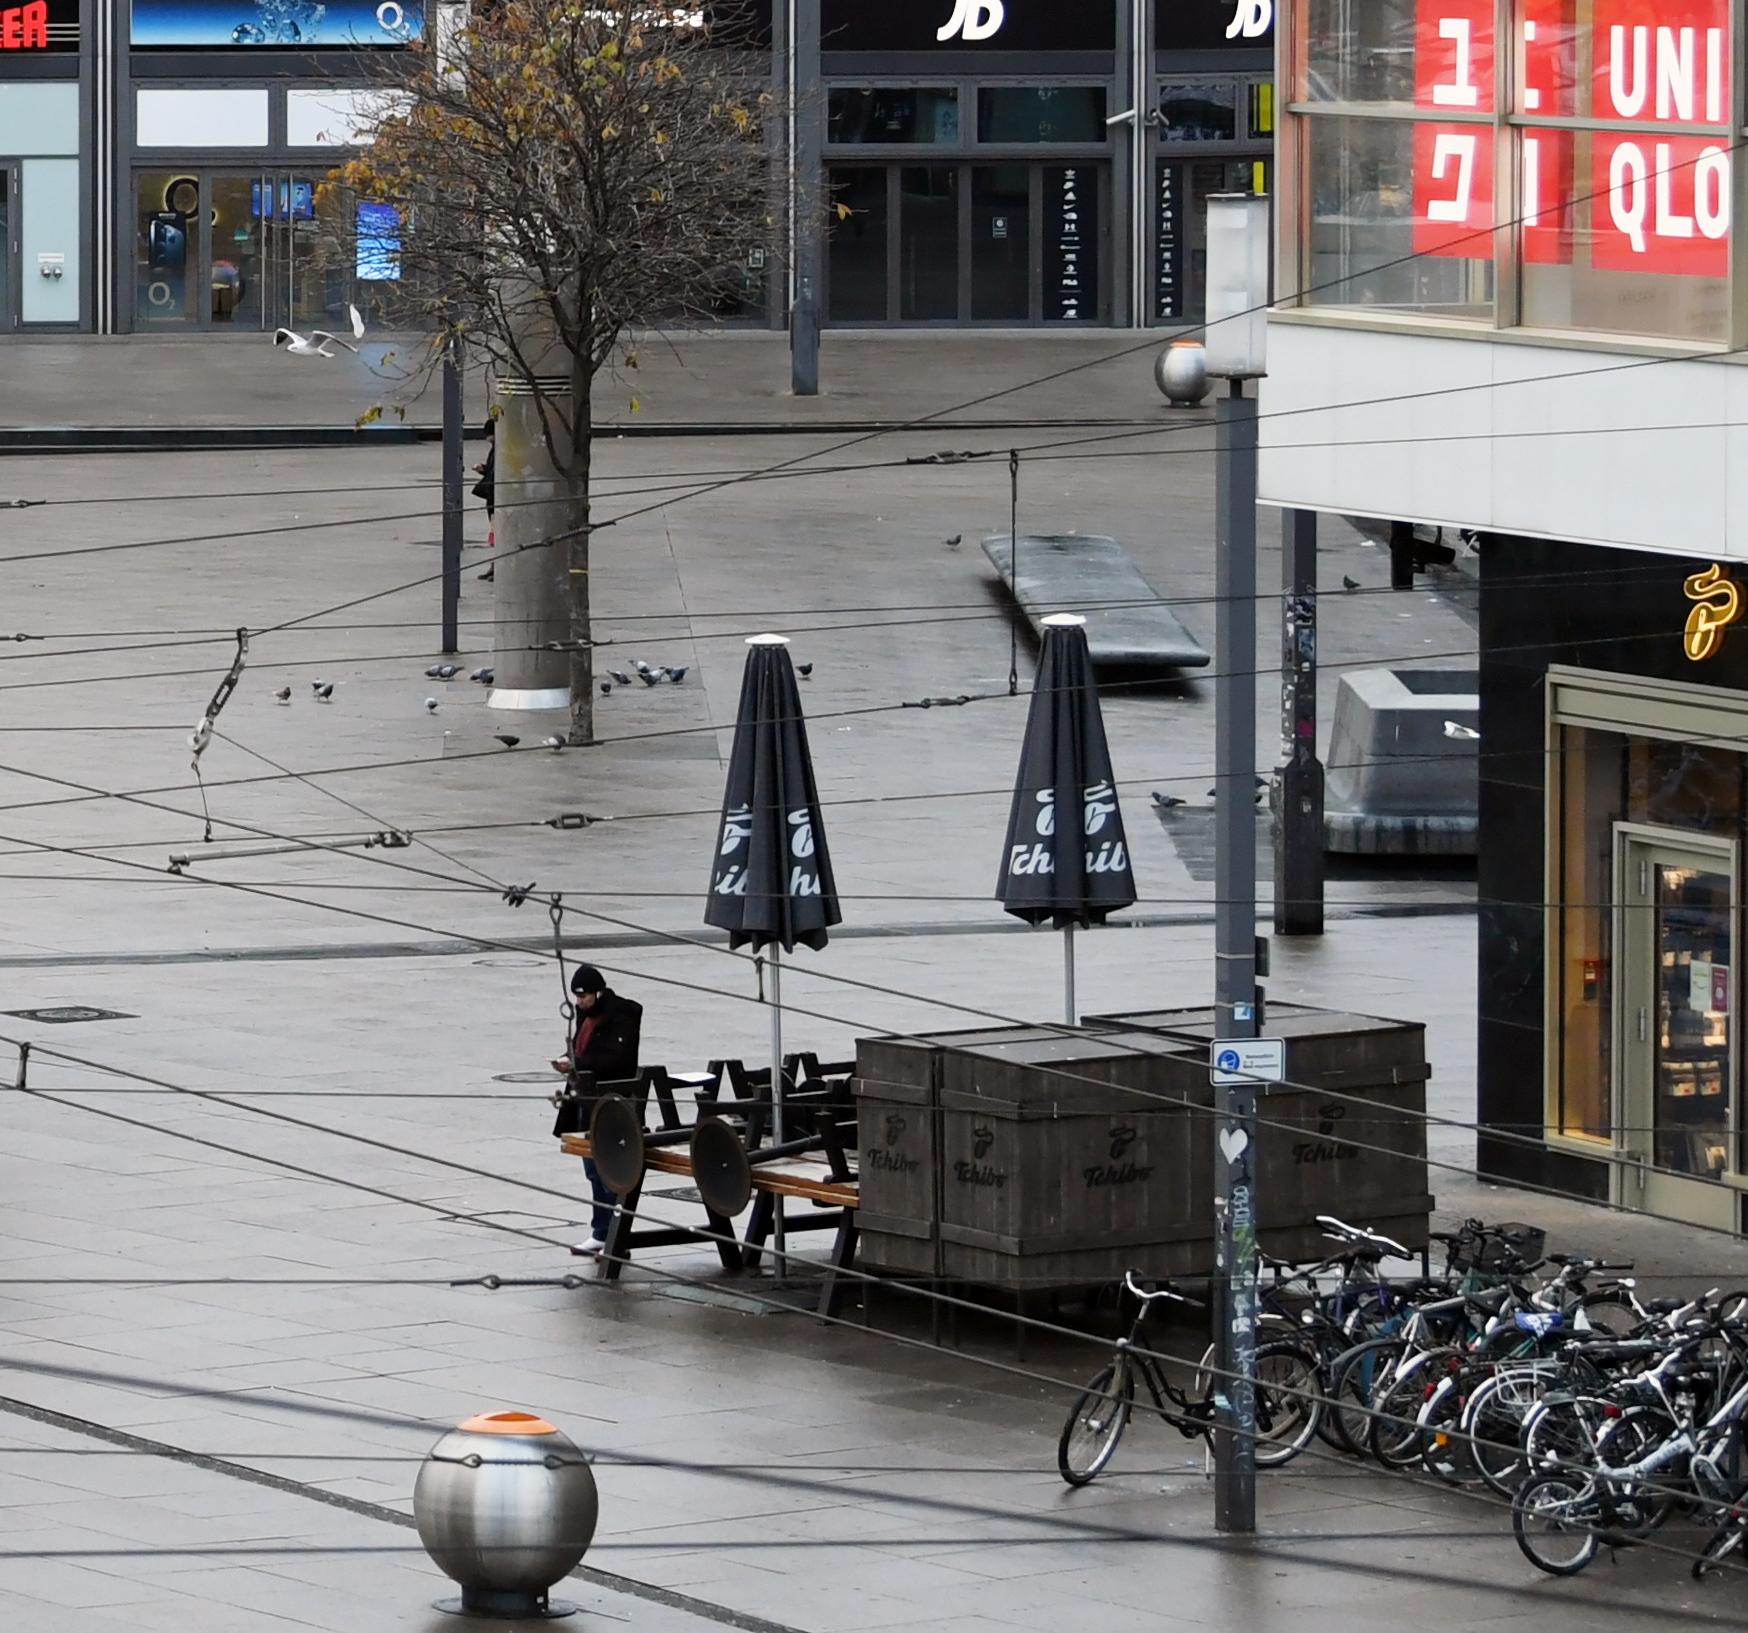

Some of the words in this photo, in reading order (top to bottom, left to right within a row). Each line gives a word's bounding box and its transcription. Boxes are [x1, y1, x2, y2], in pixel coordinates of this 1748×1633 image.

[1611, 24, 1722, 122] UNI
[1611, 141, 1730, 251] QLO
[953, 1160, 1008, 1189] Tchibo
[1083, 1164, 1151, 1189] Tchibo
